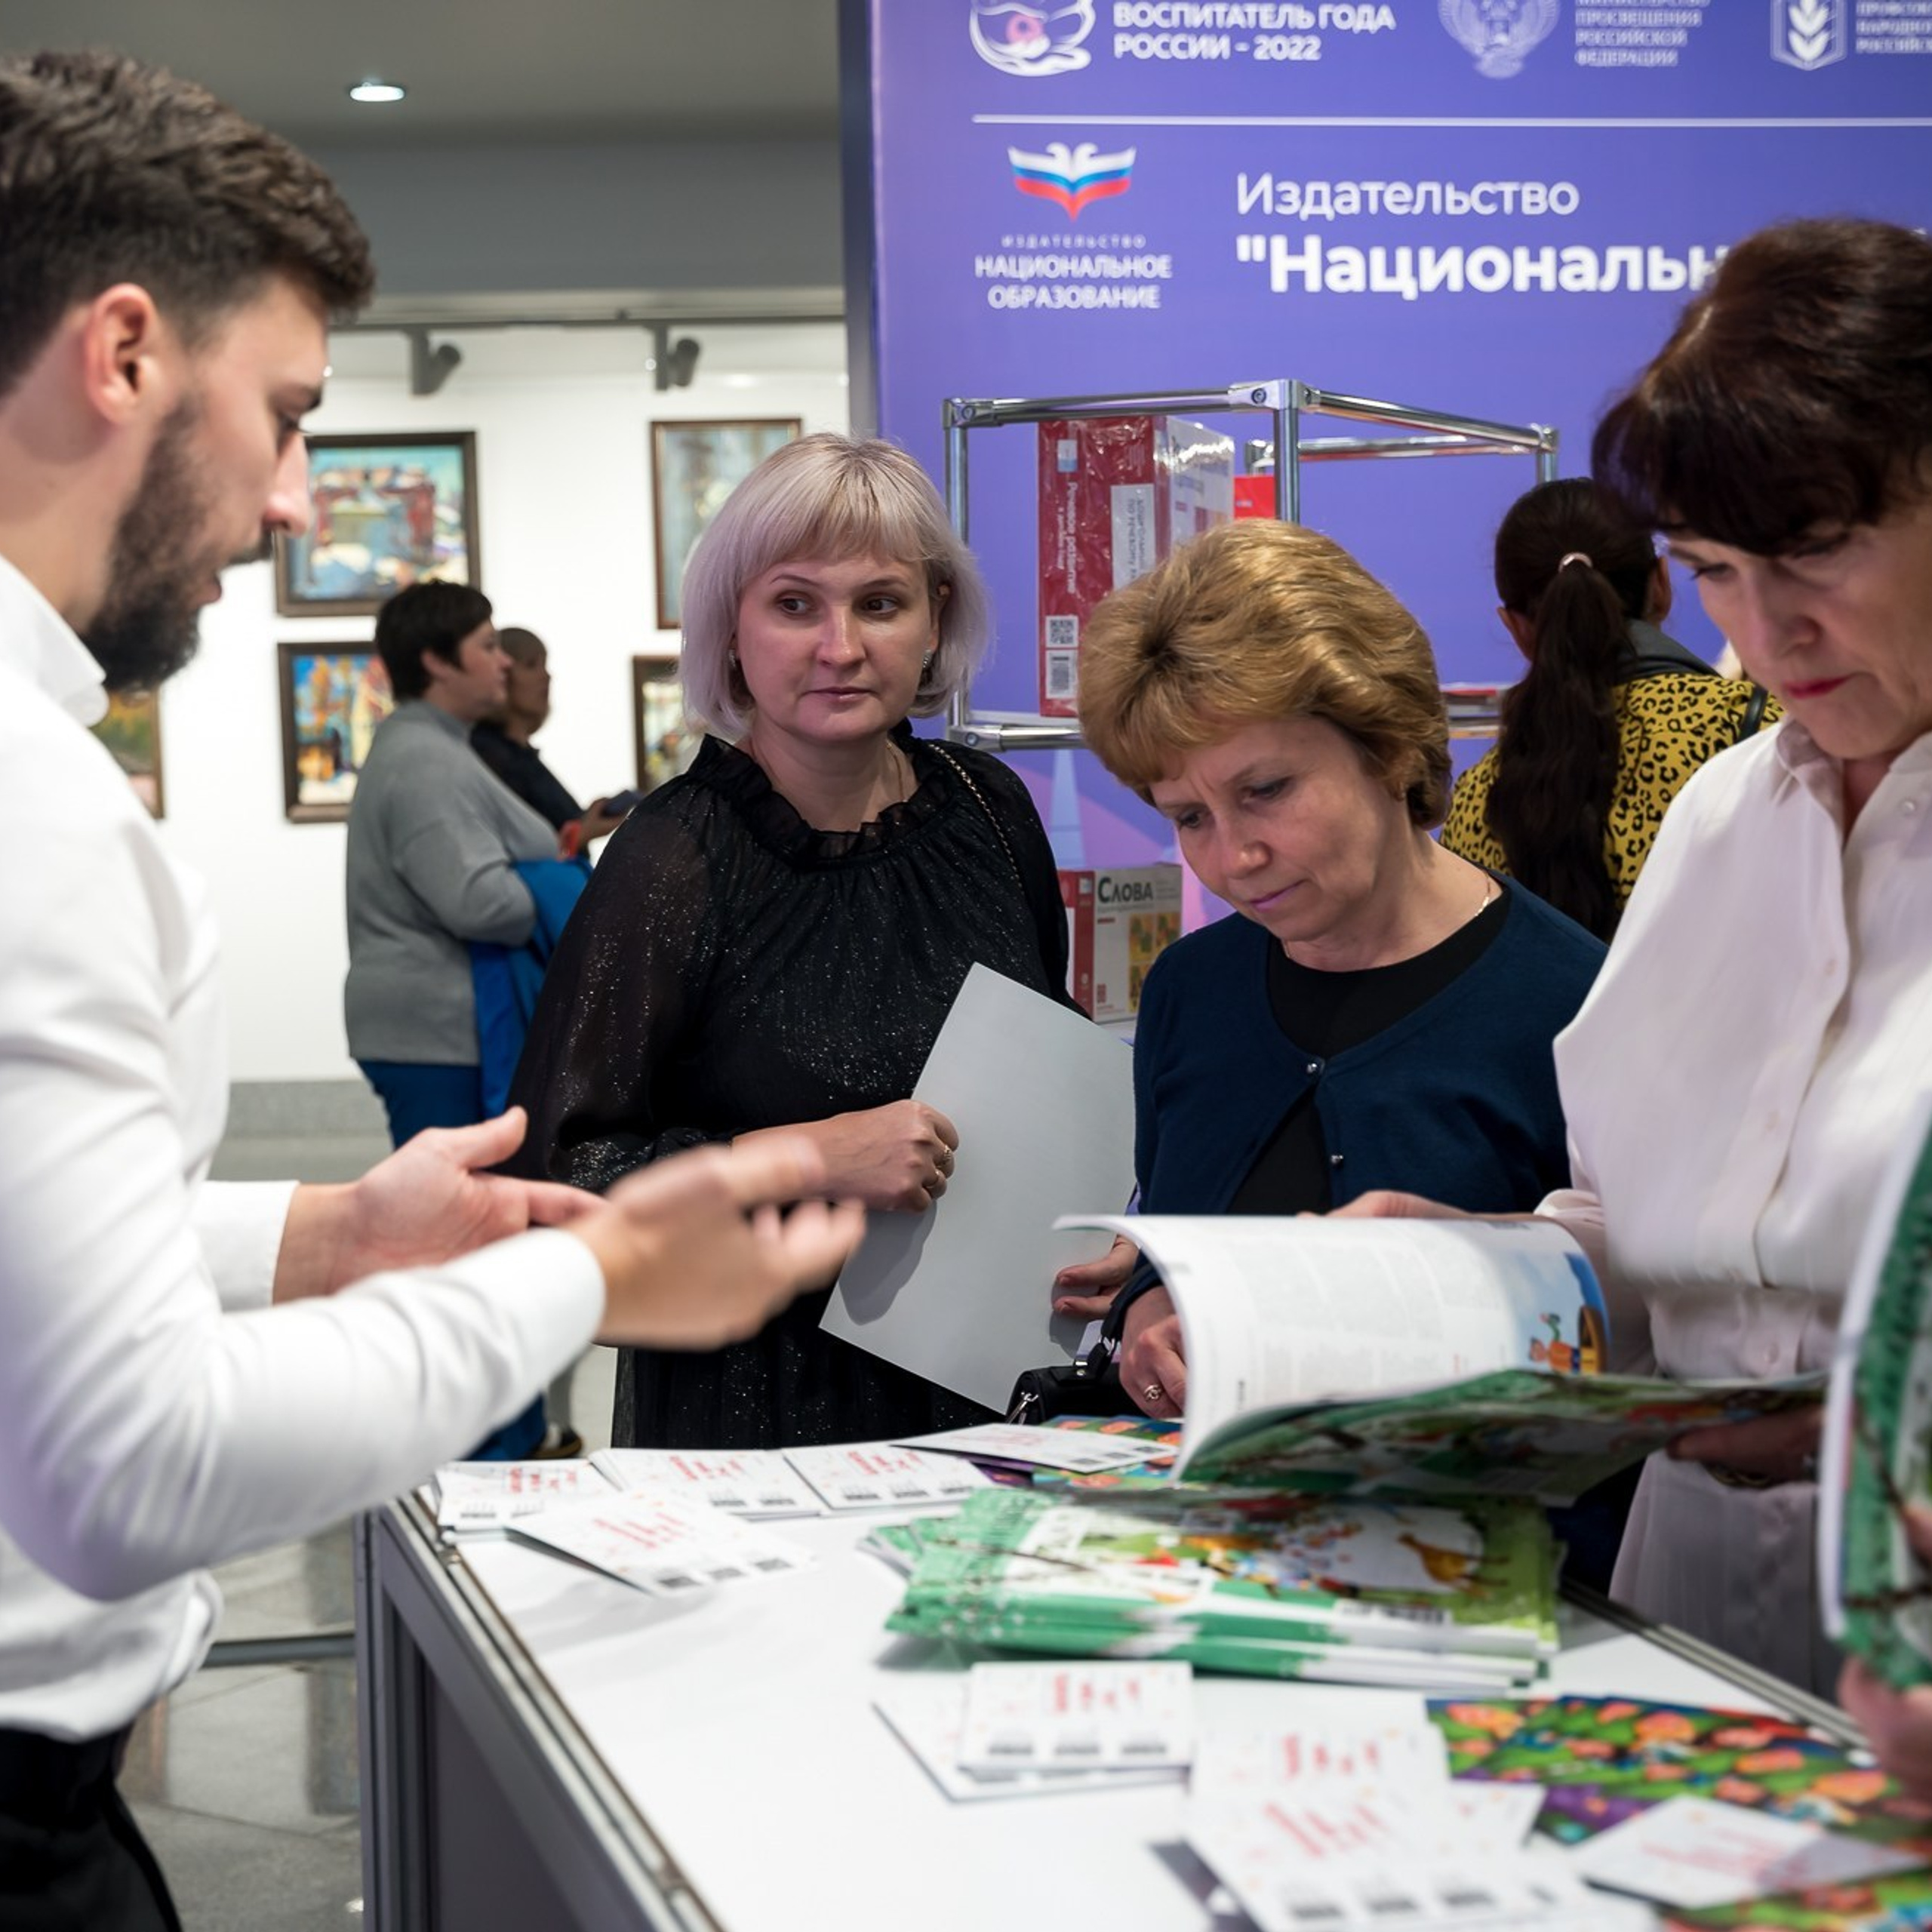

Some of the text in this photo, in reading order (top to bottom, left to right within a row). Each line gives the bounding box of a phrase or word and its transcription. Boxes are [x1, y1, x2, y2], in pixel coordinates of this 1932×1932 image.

[1112, 2, 1398, 33] ВОСПИТАТЕЛЬ ГОДА
[1113, 32, 1232, 60] РОССИИ
[1253, 35, 1322, 60] 2022
[1238, 173, 1580, 220] Издательство
[974, 254, 1174, 281] НАЦИОНАЛЬНОЕ
[987, 284, 1161, 309] ОБРАЗОВАНИЕ
